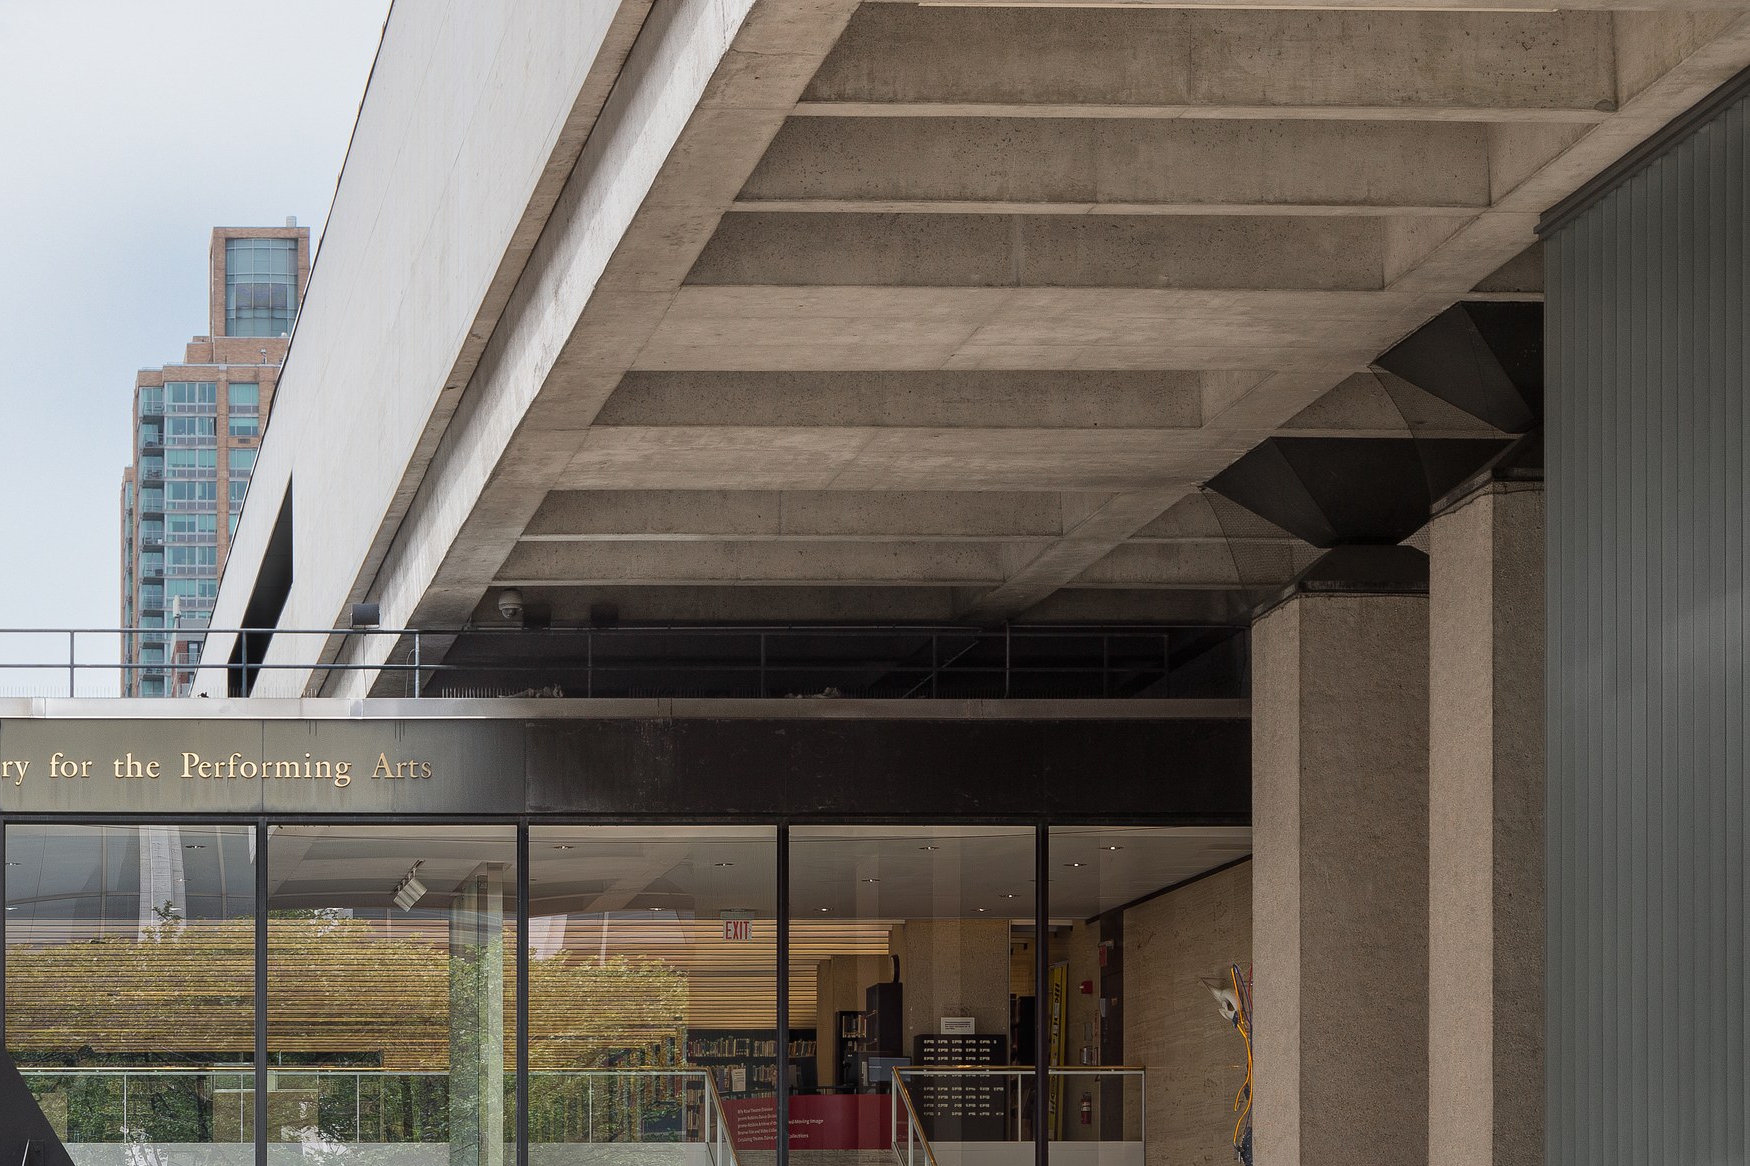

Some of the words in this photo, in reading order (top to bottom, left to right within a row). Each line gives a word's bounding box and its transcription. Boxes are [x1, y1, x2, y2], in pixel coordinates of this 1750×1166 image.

[48, 751, 93, 779] for
[114, 751, 161, 779] the
[179, 751, 353, 787] Performing
[371, 751, 433, 779] Arts
[725, 920, 750, 940] EXIT
